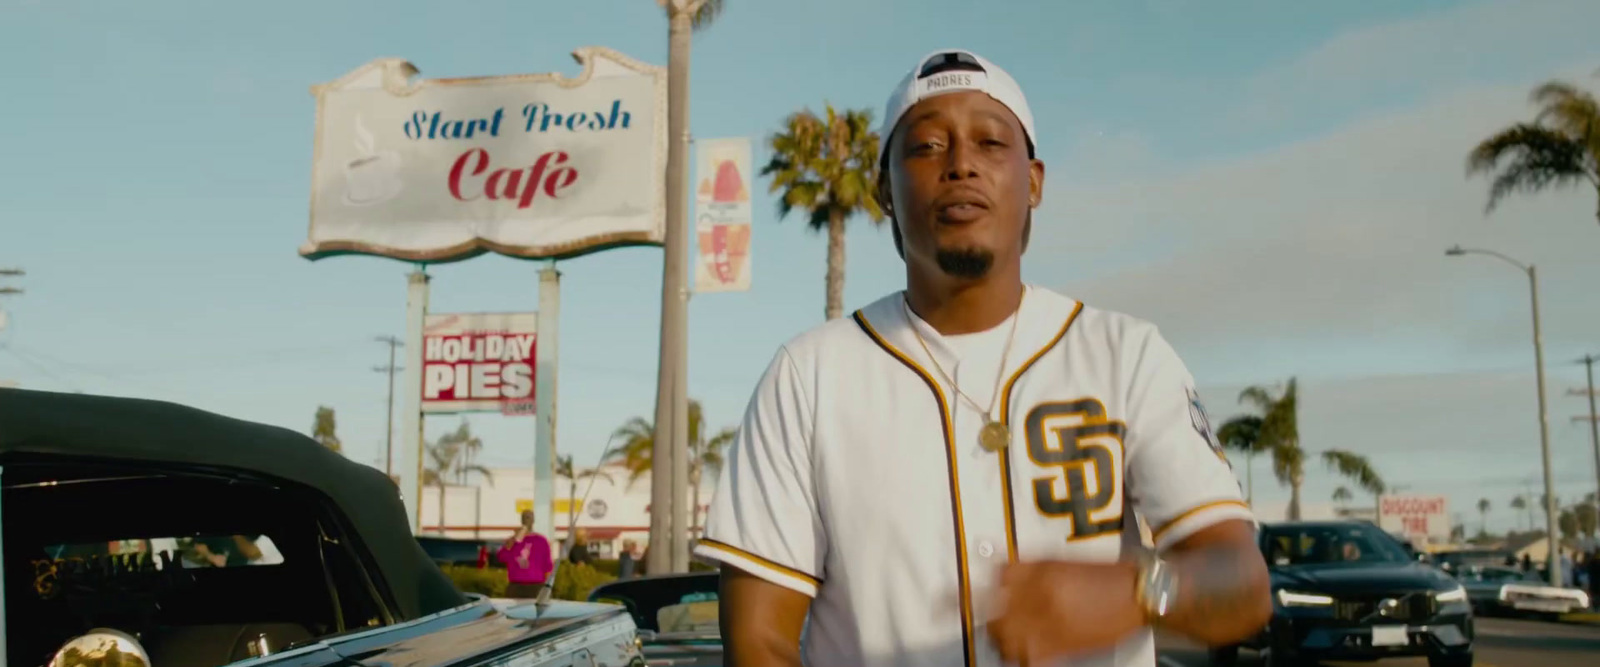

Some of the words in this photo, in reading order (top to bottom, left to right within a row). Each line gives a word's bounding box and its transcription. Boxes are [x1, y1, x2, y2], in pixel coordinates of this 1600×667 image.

[926, 74, 972, 91] PADRES
[404, 109, 504, 140] Start
[523, 99, 631, 132] Fresh
[424, 363, 533, 399] PIES
[1024, 397, 1126, 542] SD
[1383, 498, 1444, 514] DISCOUNT
[1402, 517, 1428, 534] TIRE
